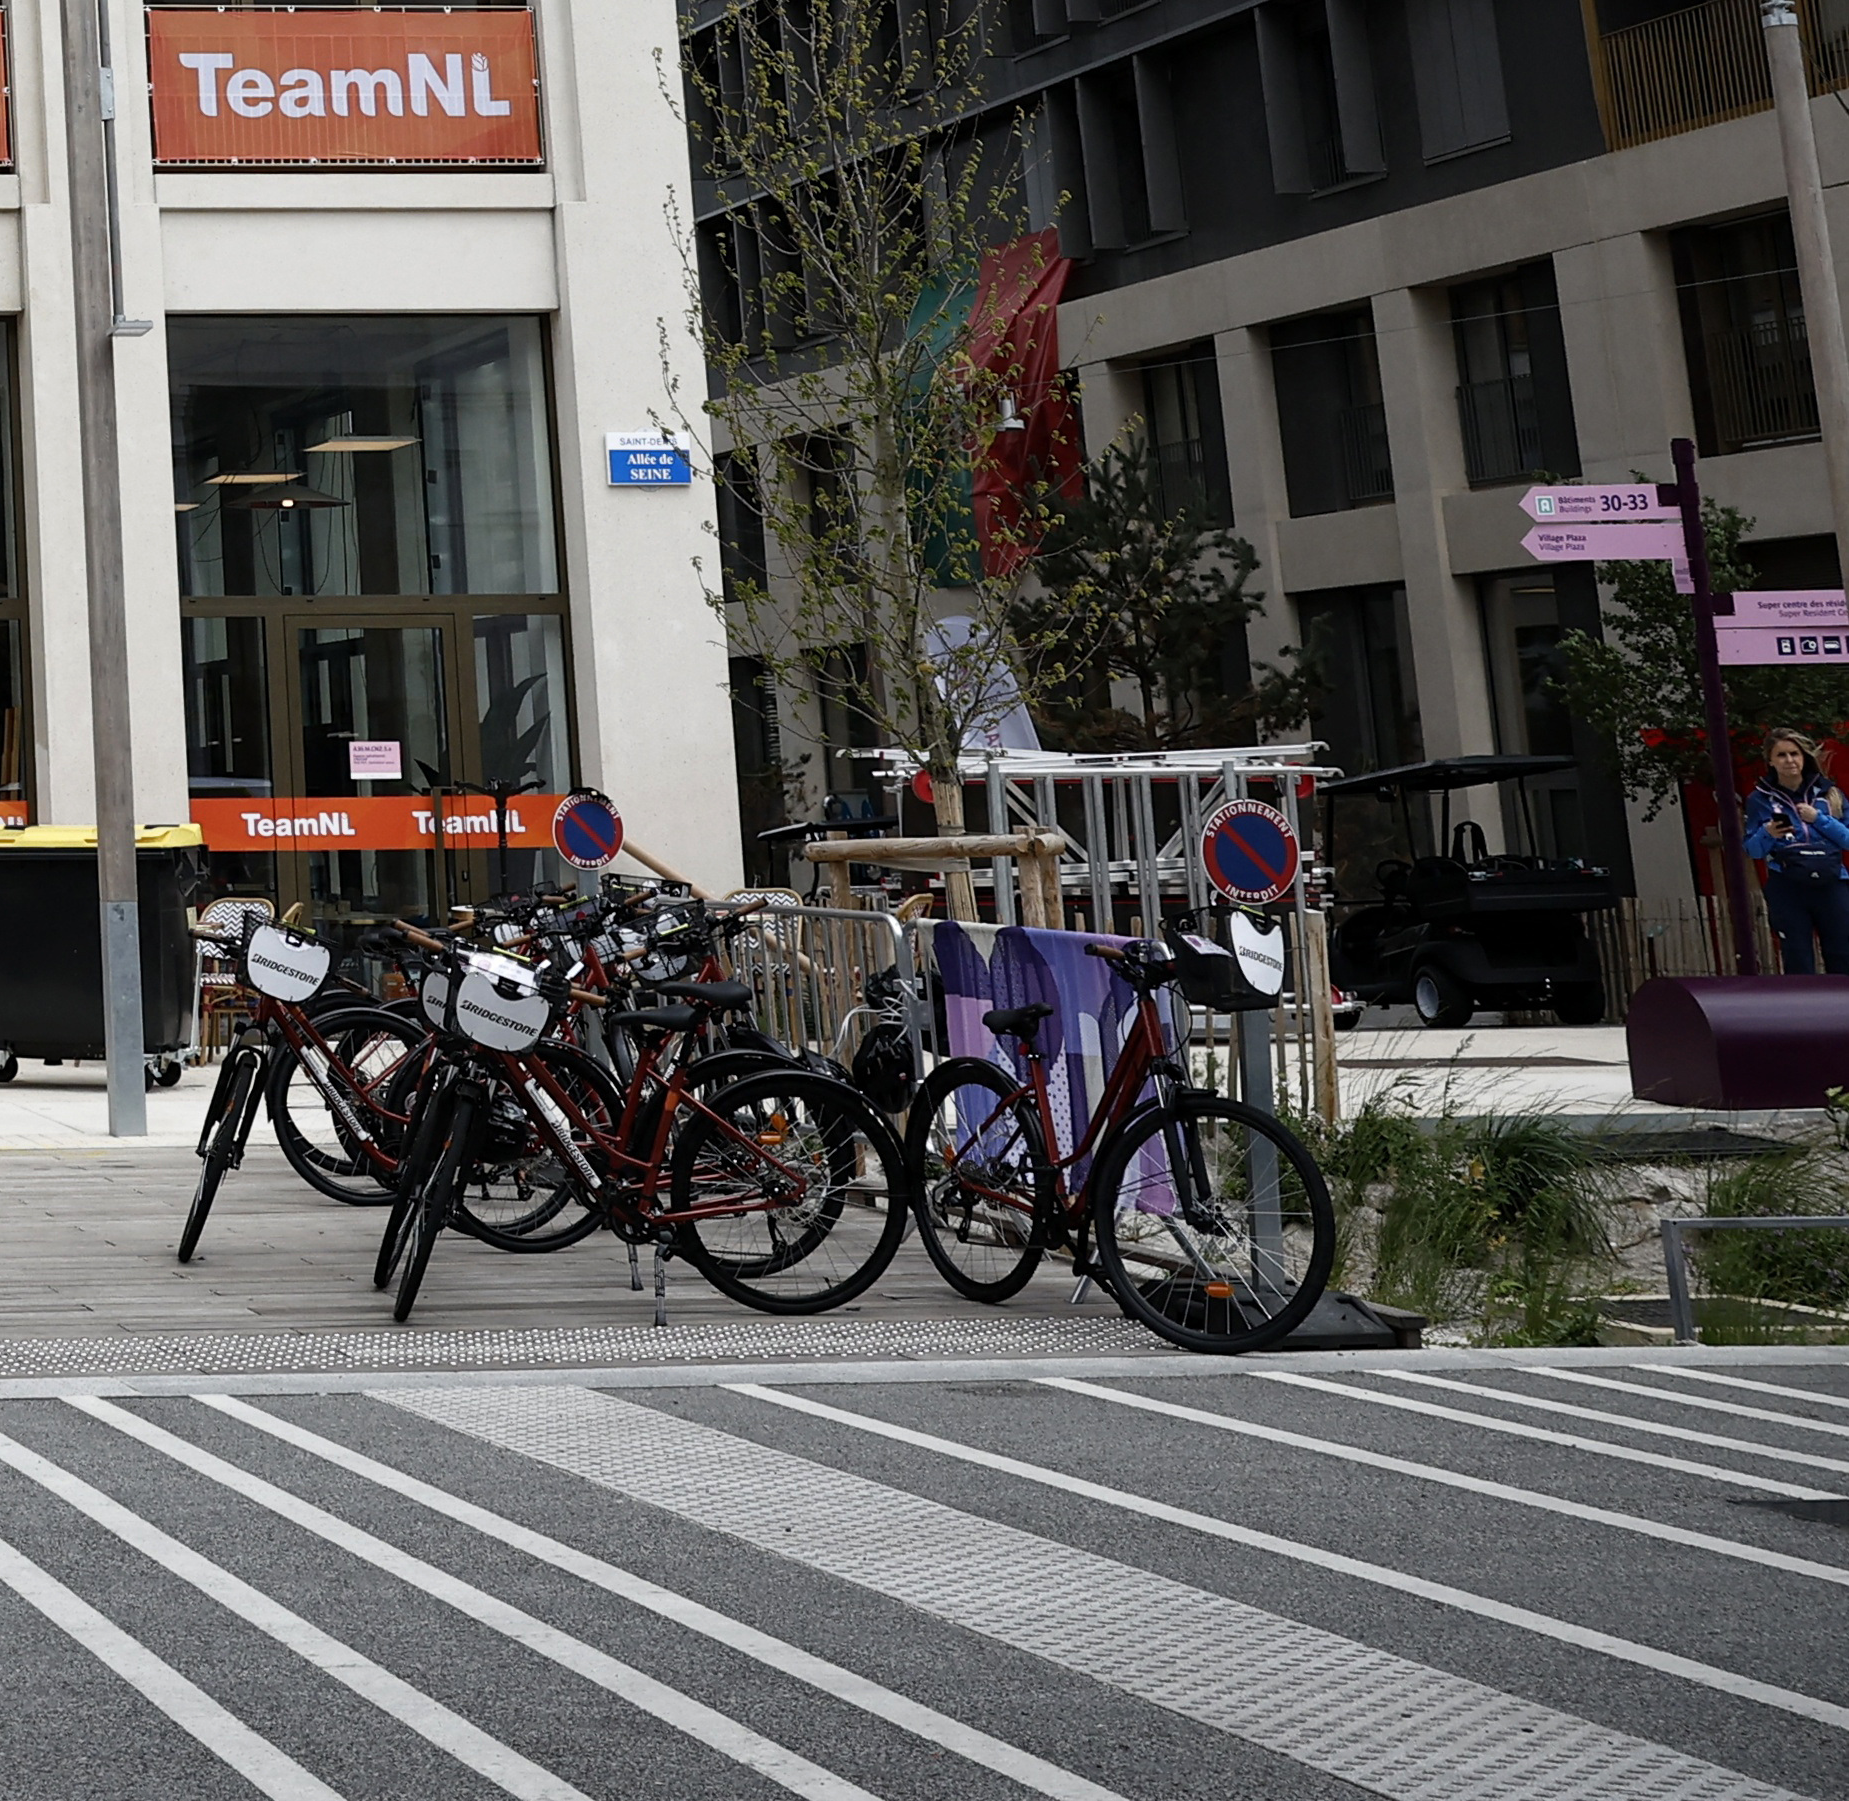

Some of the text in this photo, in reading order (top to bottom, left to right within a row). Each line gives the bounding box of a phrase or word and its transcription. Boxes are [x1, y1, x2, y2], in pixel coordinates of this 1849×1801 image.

[180, 54, 510, 117] TeamNL
[619, 437, 678, 446] SAINT-DES
[627, 453, 674, 466] Allée de
[629, 468, 672, 481] SEINE
[1558, 494, 1649, 512] Bâtiments 30-33
[1559, 504, 1593, 514] Buildings
[1538, 533, 1587, 544] Village Plaza
[1539, 542, 1585, 552] Village Plaza
[1757, 601, 1781, 610] Super
[1782, 600, 1808, 609] centre
[1810, 600, 1824, 608] des
[1778, 610, 1801, 618] Super
[1803, 608, 1836, 617] Resident
[556, 794, 620, 821] STATIONNENT
[241, 812, 355, 836] TeamNL
[1206, 802, 1293, 839] STATIONNEMENT
[1225, 883, 1279, 900] INTERDIT
[1239, 945, 1283, 973] BRIDGESTONE
[251, 952, 320, 987] BRIDGESTONE
[460, 999, 539, 1037] BRIDGESTONE
[324, 1080, 364, 1135] BRIDGESTONE
[551, 1120, 597, 1180] BRIDGESTONE
